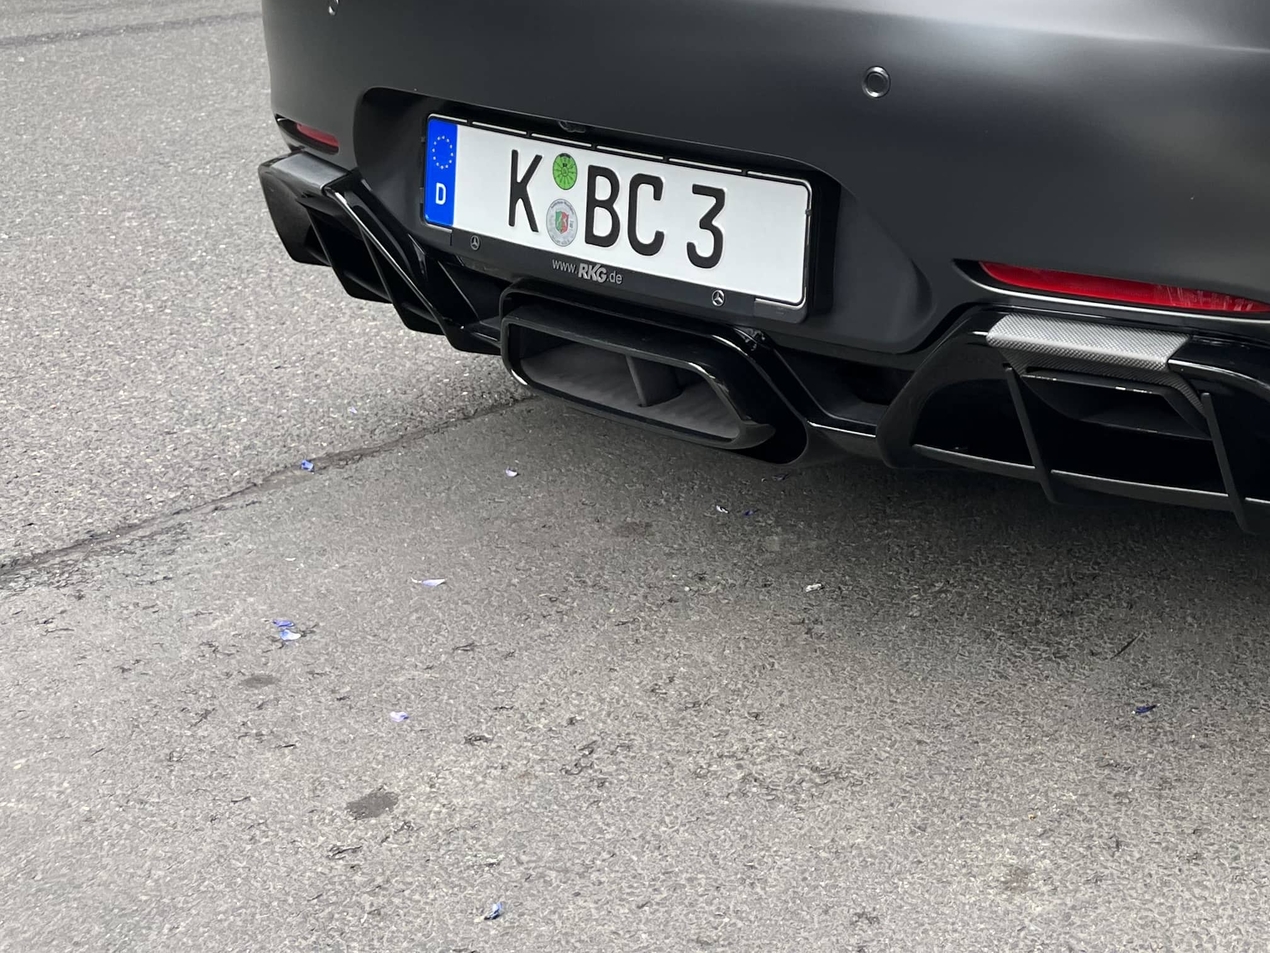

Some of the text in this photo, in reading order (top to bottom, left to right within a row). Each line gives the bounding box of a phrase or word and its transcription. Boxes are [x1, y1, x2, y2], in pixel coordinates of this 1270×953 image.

[435, 182, 447, 205] D
[508, 149, 543, 233] K
[584, 164, 665, 257] BC
[686, 183, 726, 269] 3
[552, 259, 623, 284] www.RKG.de
